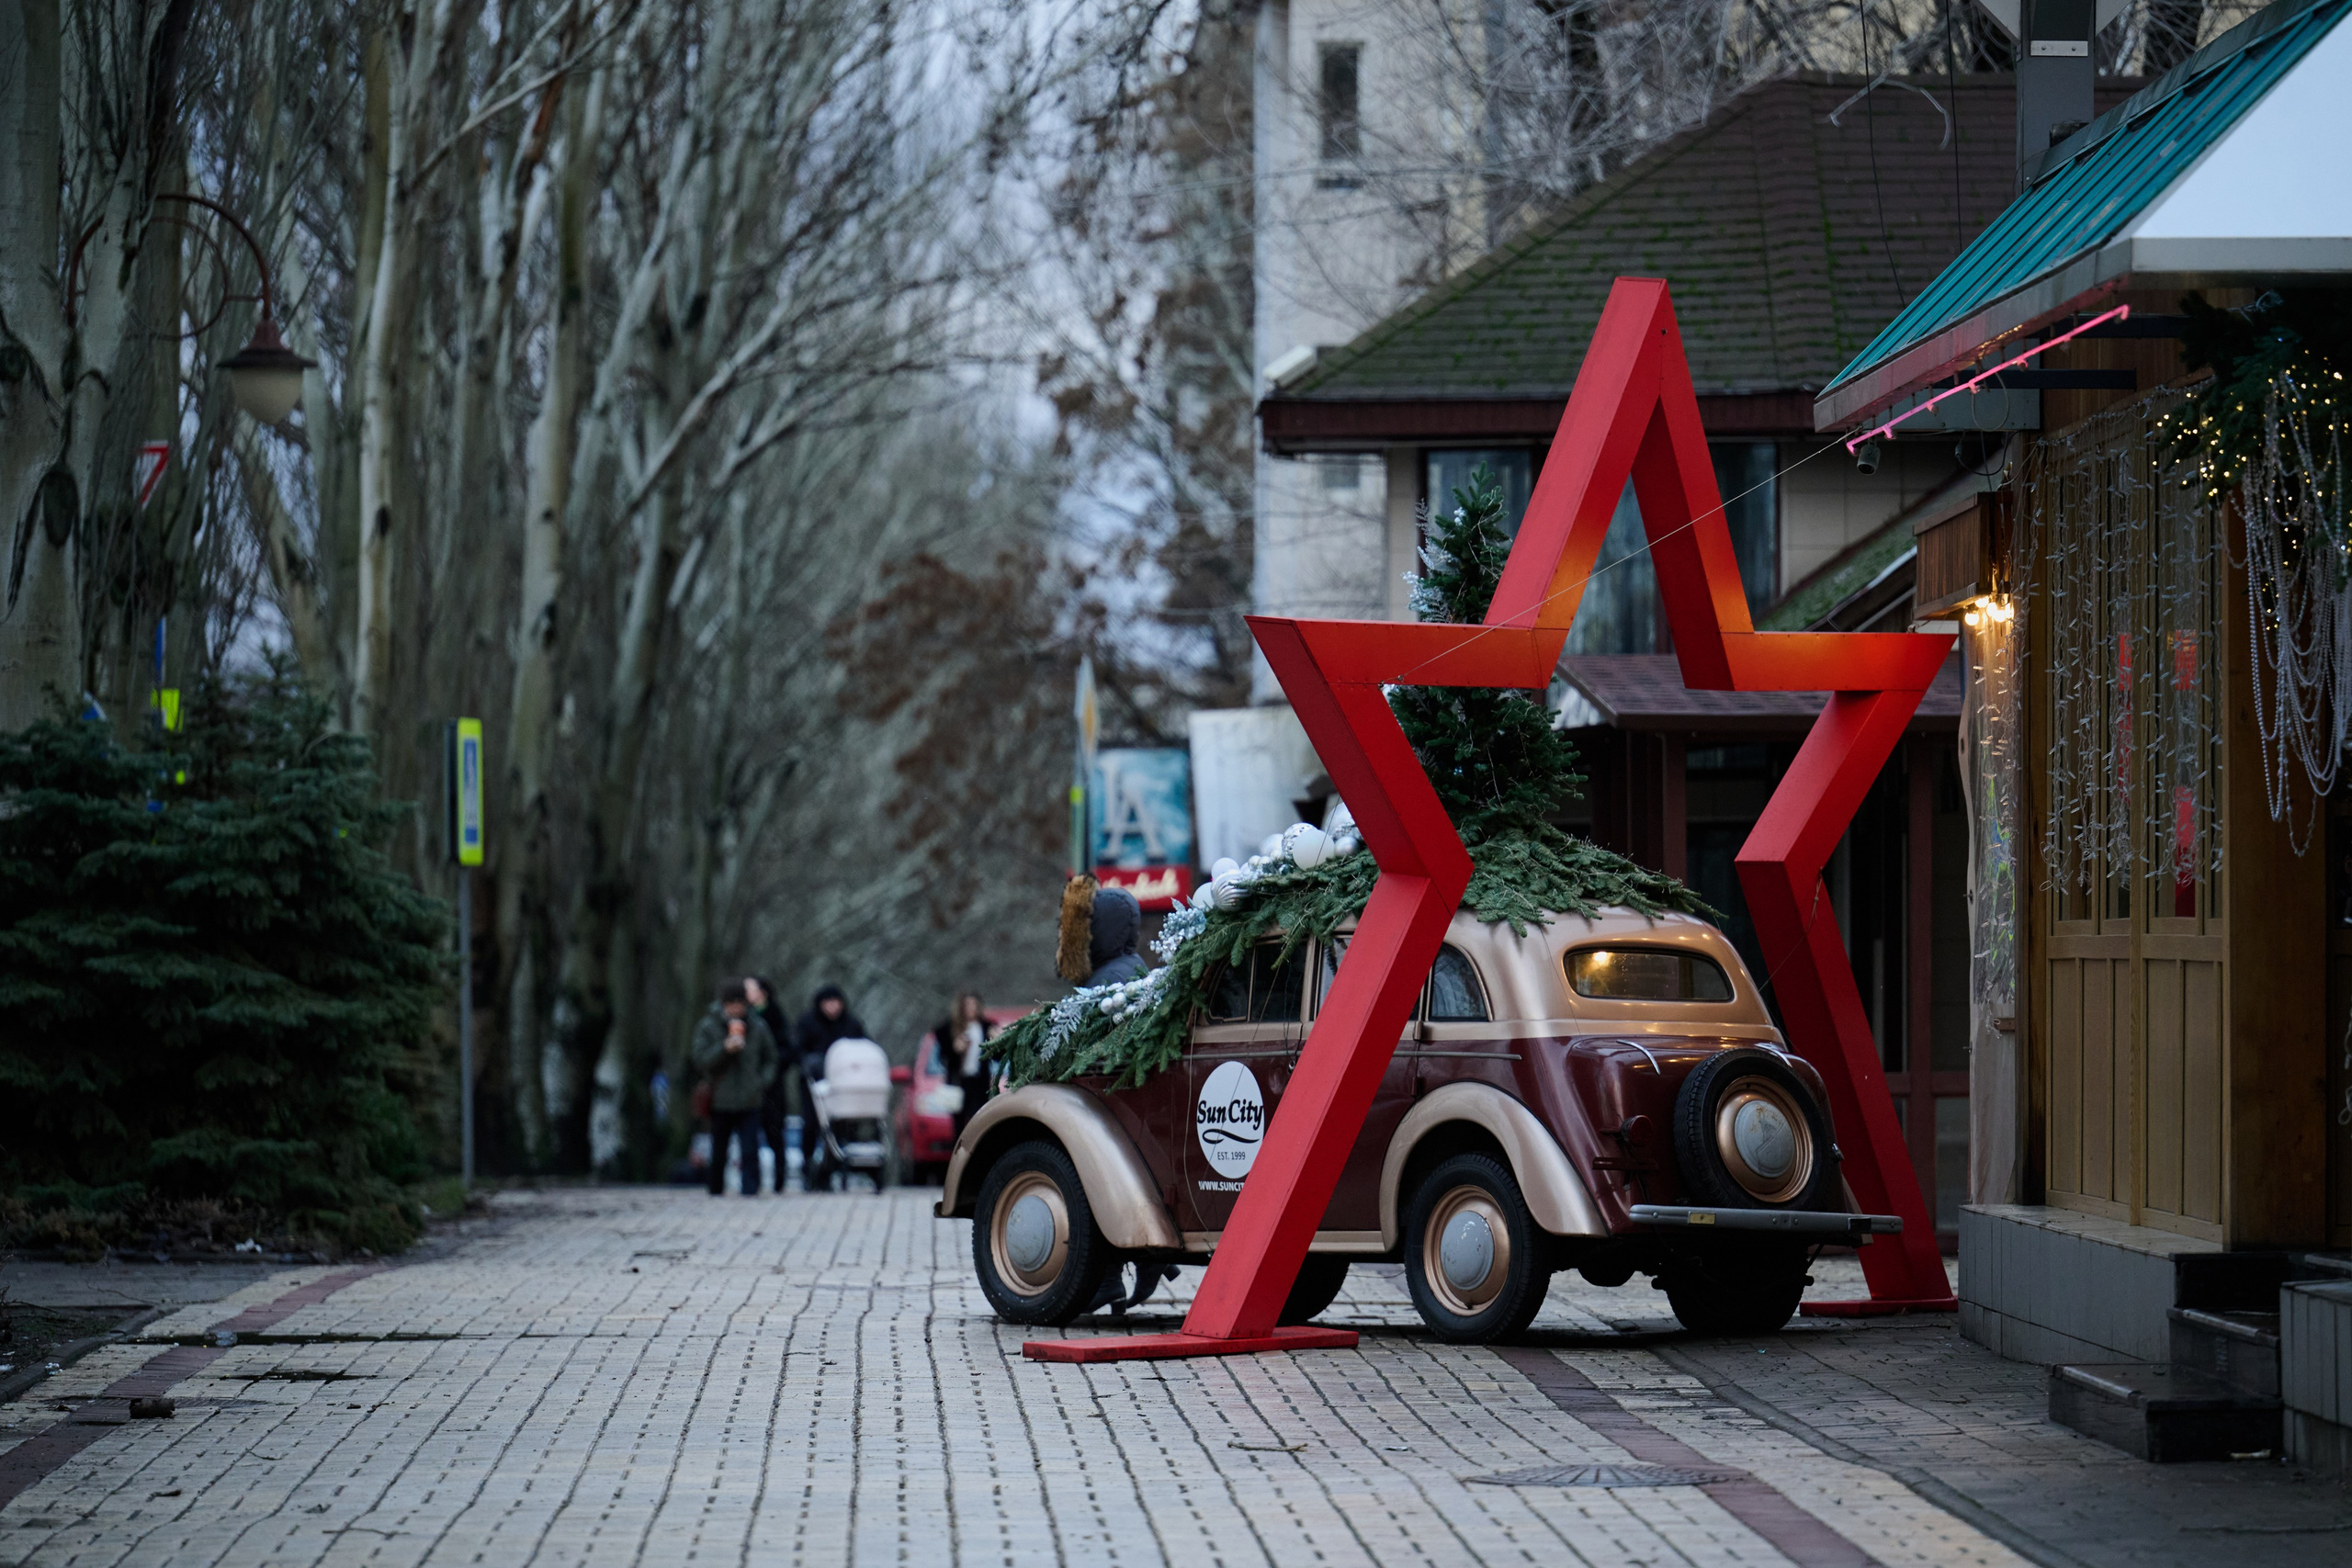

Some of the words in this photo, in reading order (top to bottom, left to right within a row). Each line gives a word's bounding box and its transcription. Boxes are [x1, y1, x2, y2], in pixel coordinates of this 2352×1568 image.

[1197, 1100, 1227, 1123] Sun
[1228, 1099, 1264, 1130] City
[1217, 1151, 1230, 1161] EST.
[1231, 1151, 1246, 1161] 1999
